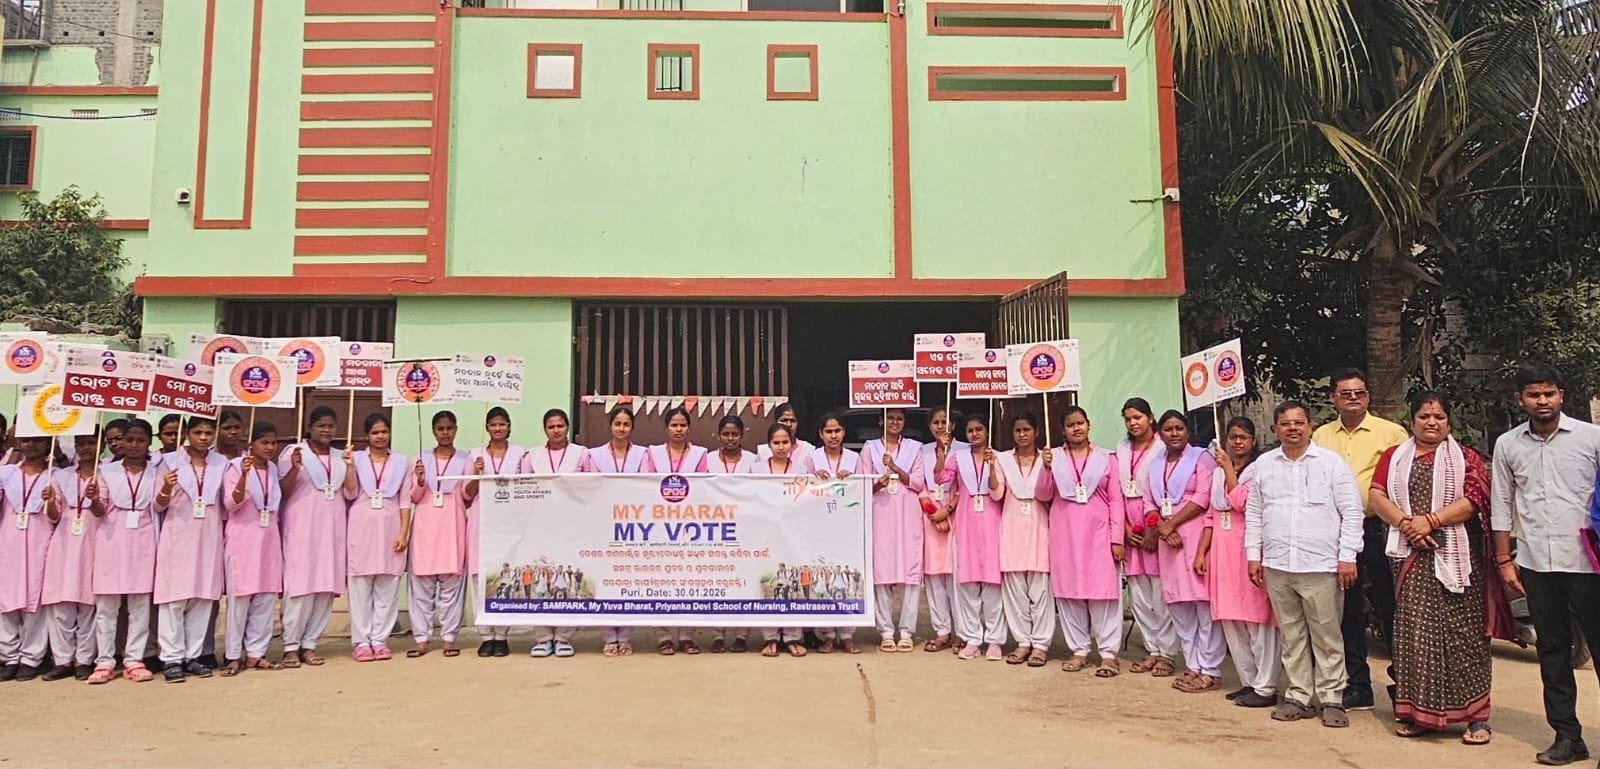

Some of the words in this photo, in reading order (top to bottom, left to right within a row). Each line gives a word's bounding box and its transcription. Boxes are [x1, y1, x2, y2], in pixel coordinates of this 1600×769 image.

[69, 376, 112, 390] ଭୋଟ
[116, 377, 144, 392] ଦିଅ
[166, 380, 186, 392] ମୋ
[189, 384, 207, 395] ମତ
[151, 393, 171, 406] ମୋ
[613, 504, 644, 519] MY
[652, 504, 738, 519] BHARAT
[614, 522, 655, 541] MY
[664, 521, 737, 542] VOTE
[620, 588, 643, 598] Puri,
[646, 588, 672, 597] Date:
[674, 588, 727, 597] 30.01.2026
[490, 602, 528, 612] Organised
[528, 602, 541, 612] by:
[542, 602, 588, 612] SAMPARK,
[589, 602, 601, 612] My
[603, 602, 623, 611] Yuva
[624, 602, 654, 612] Bharat,
[655, 602, 691, 612] Priyanka
[693, 602, 711, 611] Devi
[712, 602, 742, 611] School
[743, 602, 752, 611] of
[753, 602, 788, 612] Nursing,
[838, 602, 859, 611] Trust
